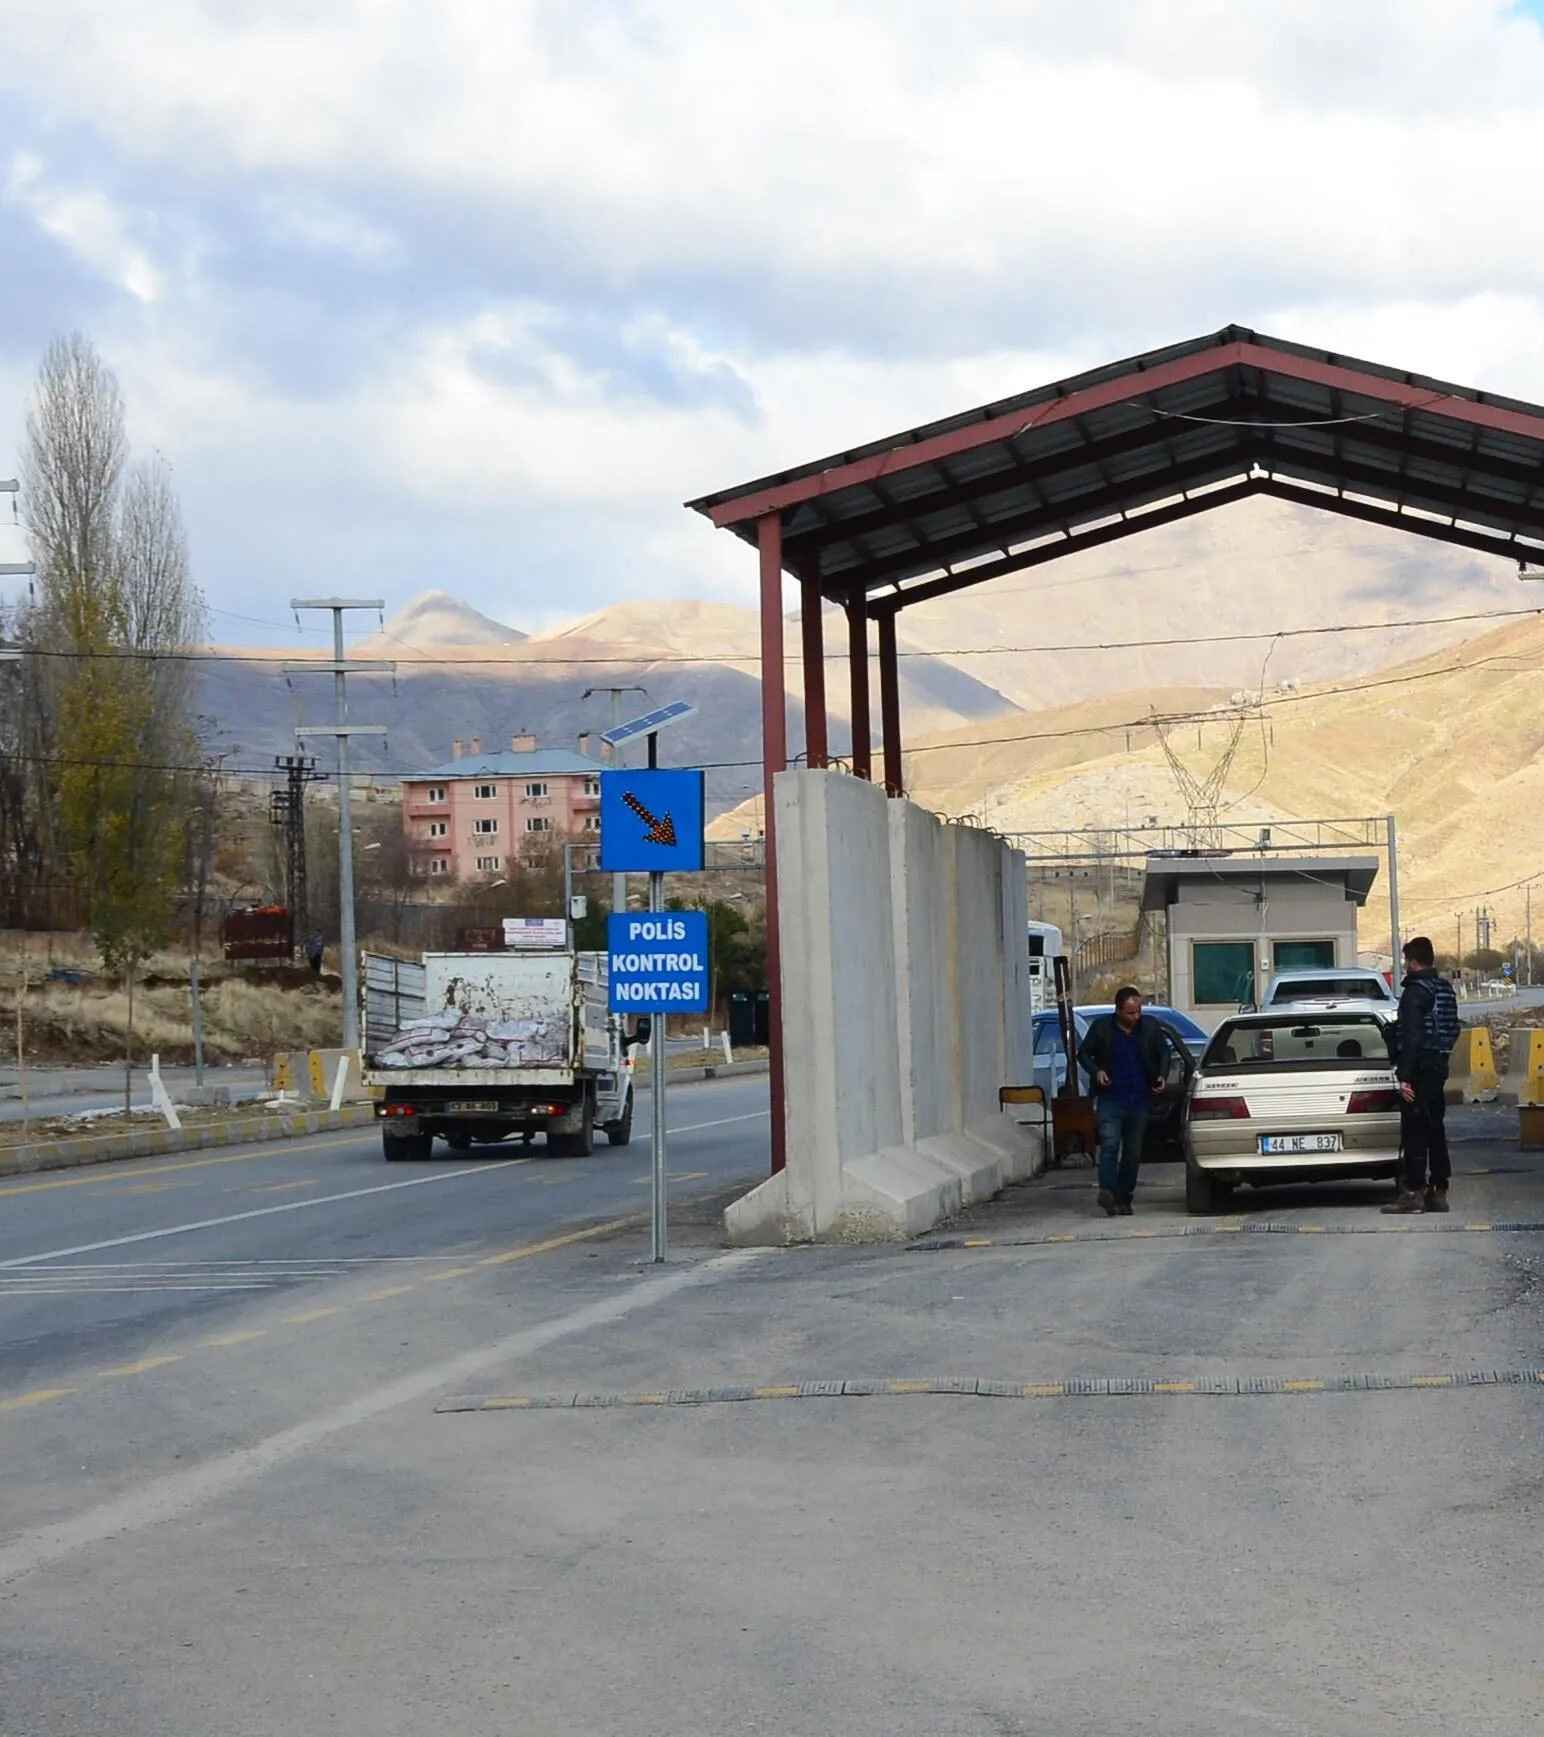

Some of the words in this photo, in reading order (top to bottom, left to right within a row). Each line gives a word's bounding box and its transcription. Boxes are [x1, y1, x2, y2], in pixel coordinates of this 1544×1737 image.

[629, 918, 686, 941] POLİS
[612, 953, 704, 972] KONTROL
[616, 982, 700, 1001] NOKTASI
[1271, 1138, 1285, 1150] 44
[1316, 1135, 1337, 1148] 837
